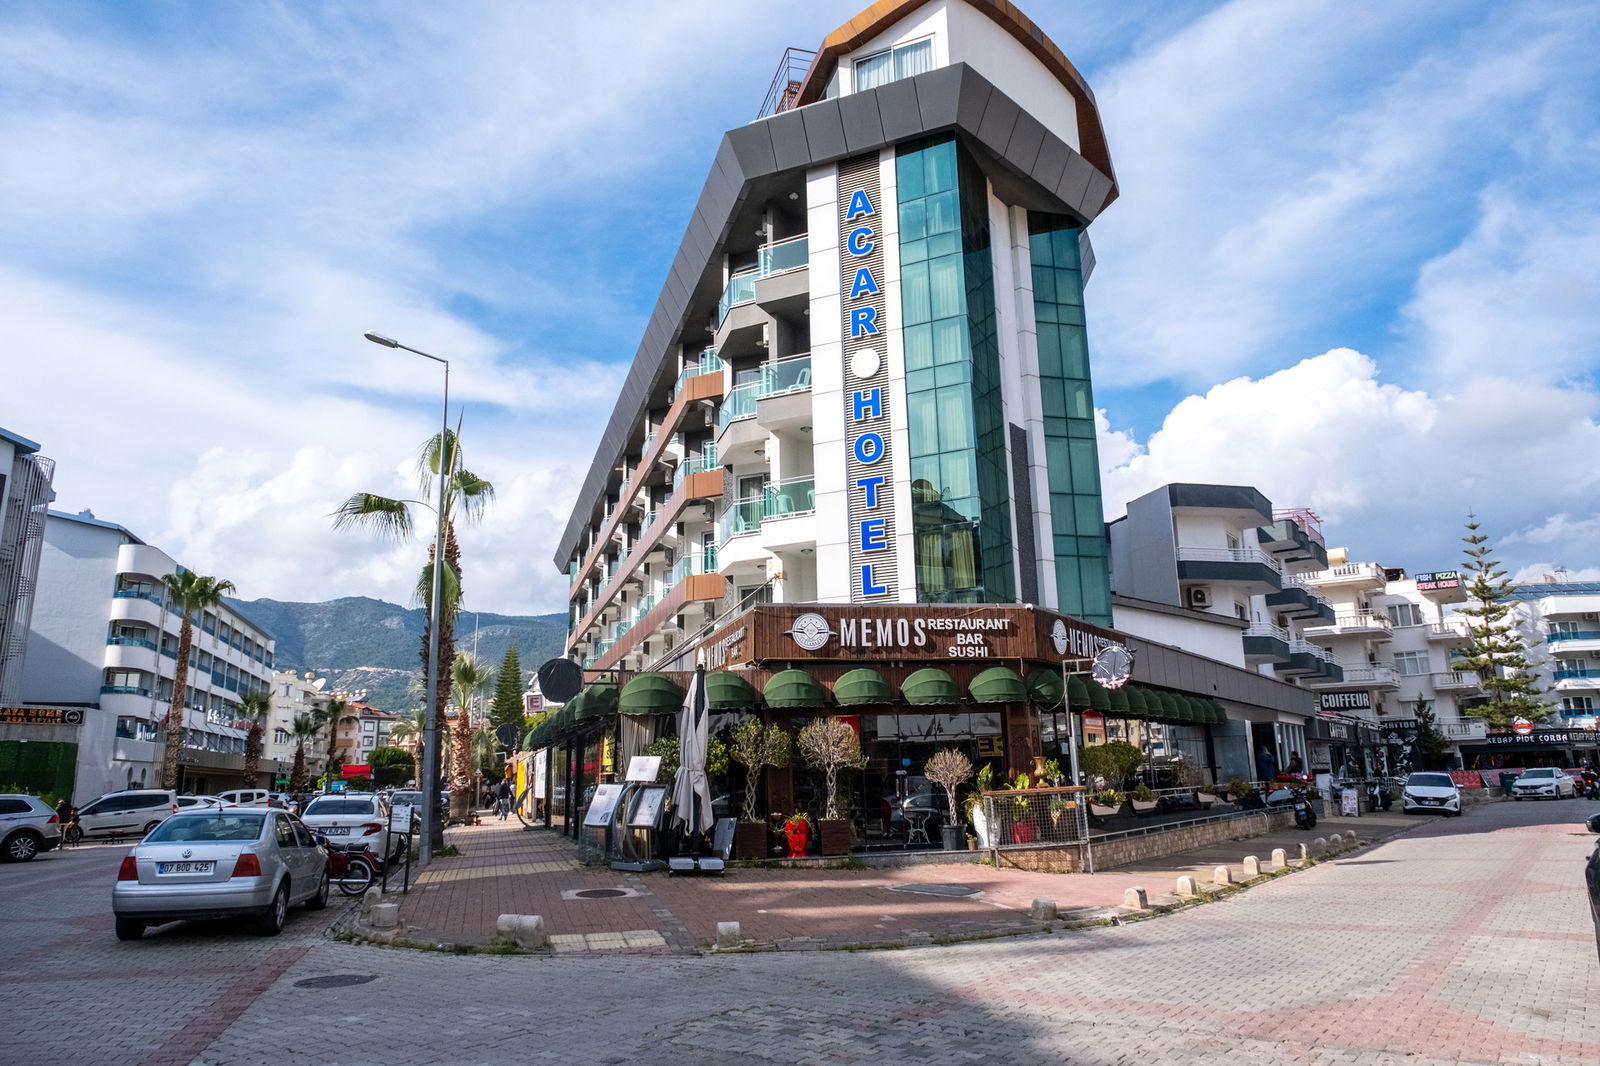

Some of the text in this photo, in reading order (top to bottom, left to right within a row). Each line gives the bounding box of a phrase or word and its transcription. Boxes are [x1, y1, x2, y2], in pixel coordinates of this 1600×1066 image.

[845, 189, 888, 597] ACAR HOTEL
[1435, 571, 1457, 580] PIZZA
[1417, 579, 1459, 590] STEAK HOUSE
[840, 618, 927, 647] MEMOS
[928, 618, 1010, 630] RESTAURANT
[957, 633, 984, 645] BAR
[1069, 628, 1100, 659] MEMOS
[948, 646, 988, 657] SUSHI
[1321, 692, 1370, 709] COIFFEUR
[0, 707, 25, 716] AYA
[1486, 736, 1513, 744] KEBAP
[164, 864, 174, 873] 07
[194, 863, 209, 872] 425
